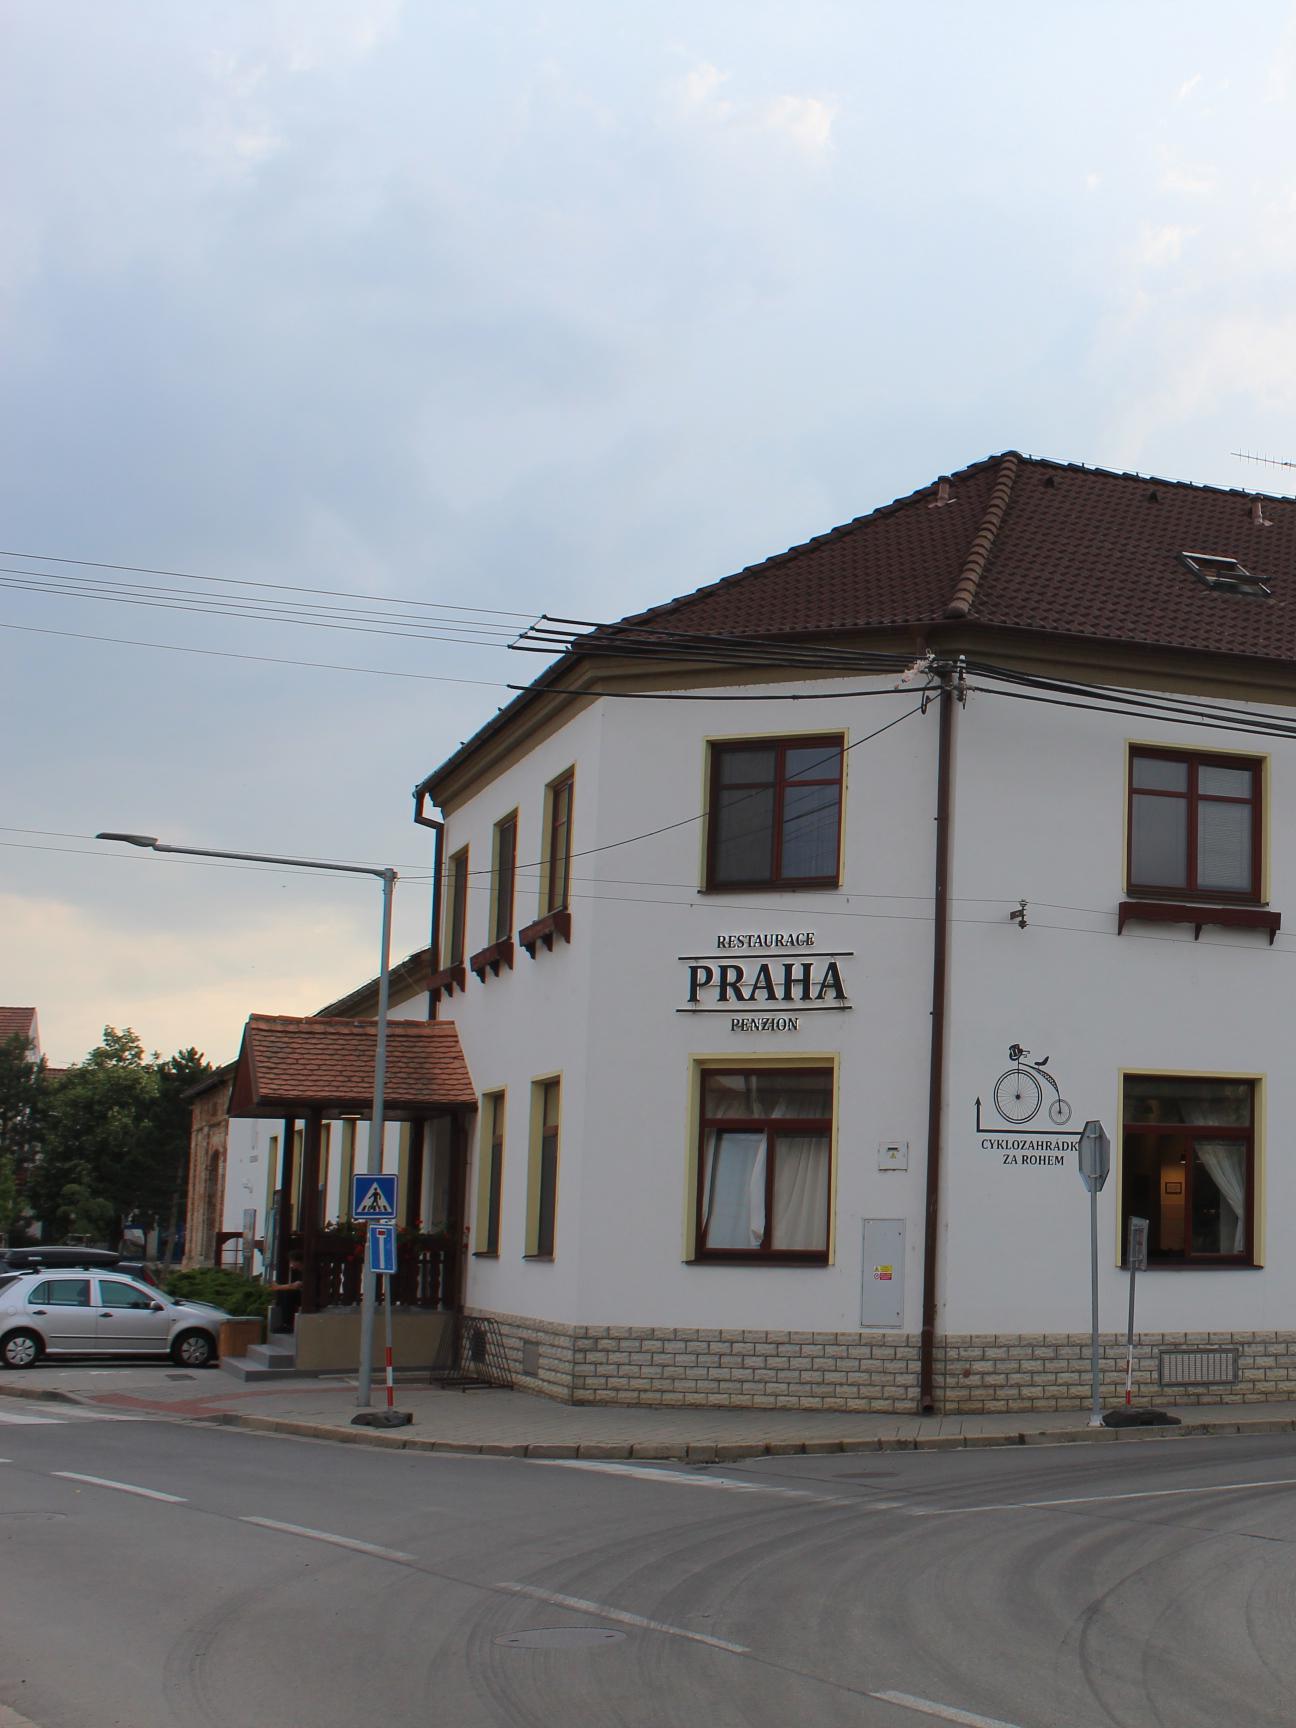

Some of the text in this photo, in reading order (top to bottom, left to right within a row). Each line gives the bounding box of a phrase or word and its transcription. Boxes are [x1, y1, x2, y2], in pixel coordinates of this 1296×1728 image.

[717, 932, 815, 949] RESTAURACE
[687, 961, 848, 1003] PRAHA
[730, 1017, 799, 1032] PENZION
[981, 1137, 1079, 1152] CYKLOZAHRÁDK
[1003, 1154, 1064, 1166] ZA ROHEM
